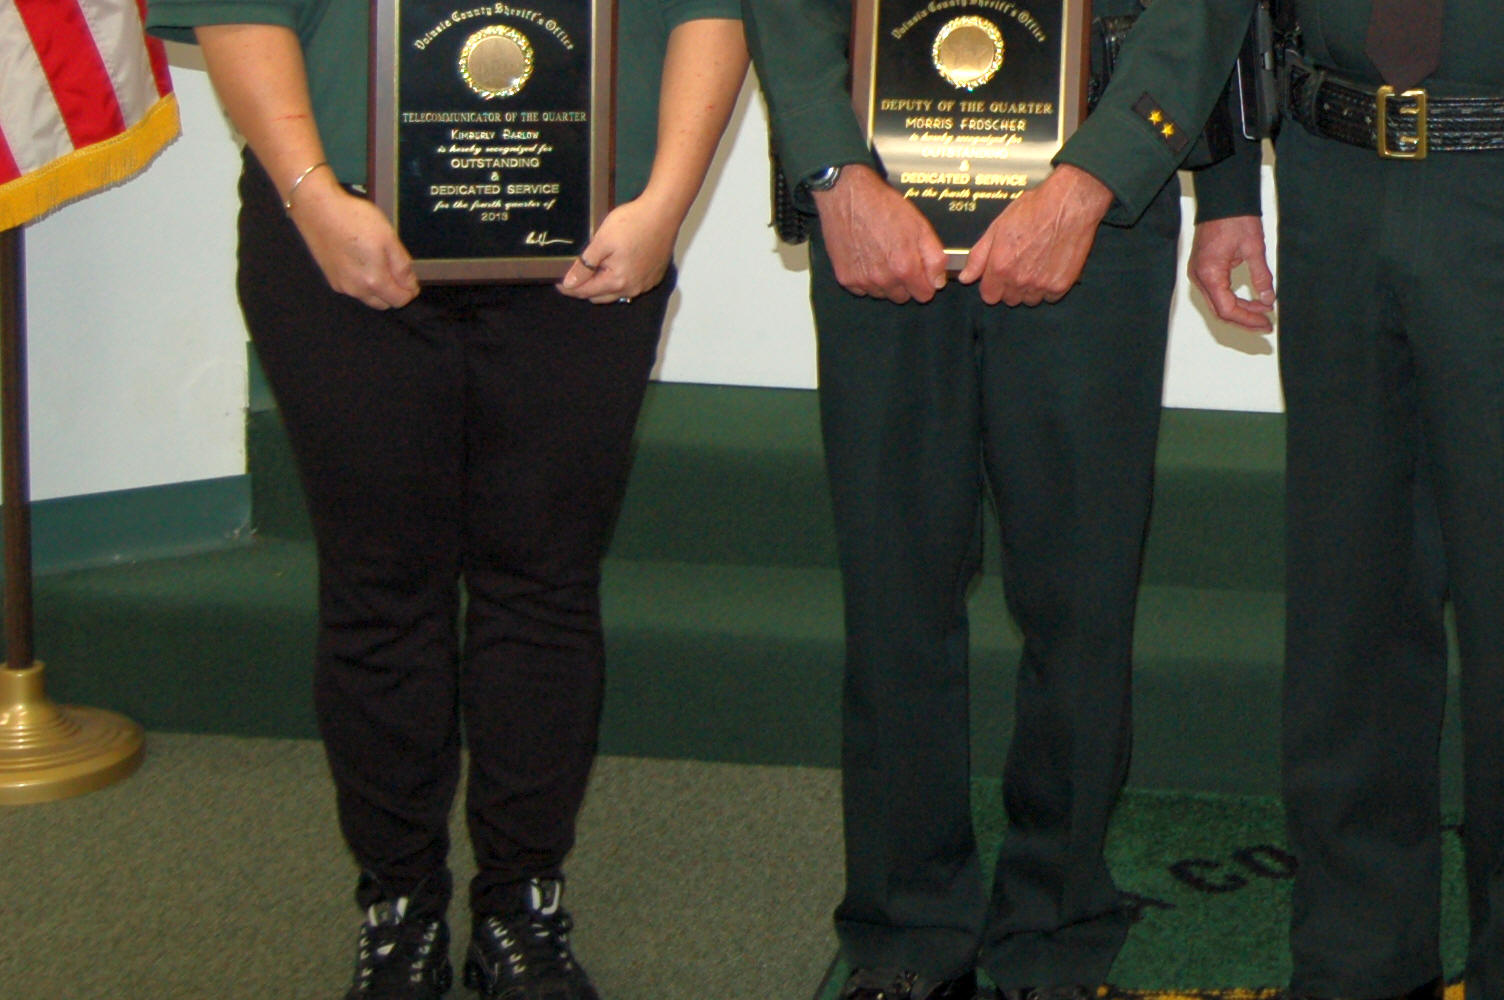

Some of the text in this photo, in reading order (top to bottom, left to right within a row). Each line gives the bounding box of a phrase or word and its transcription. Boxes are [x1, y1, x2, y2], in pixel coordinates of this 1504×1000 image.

[451, 5, 492, 22] County
[494, 2, 545, 26] Sheriff's
[545, 19, 574, 50] Office
[1017, 10, 1046, 42] Office
[881, 99, 1053, 115] DEPUTY OF THE QUARTER
[403, 112, 587, 123] TELECOMMUNICATOR OF THE QUARTER
[905, 117, 1027, 131] MORRIS FROSCHER
[1006, 134, 1023, 145] for
[437, 144, 552, 155] is hereby recognized for
[451, 158, 540, 168] OUTSTANDING
[959, 160, 970, 172] &
[490, 171, 499, 181] &
[901, 172, 1027, 186] DEDICATED SERVICE
[430, 184, 559, 195] DEDICATED SERVICE
[904, 187, 920, 198] for
[922, 187, 937, 197] the
[433, 200, 556, 211] for the fourth quarter of
[949, 201, 976, 212] 2013
